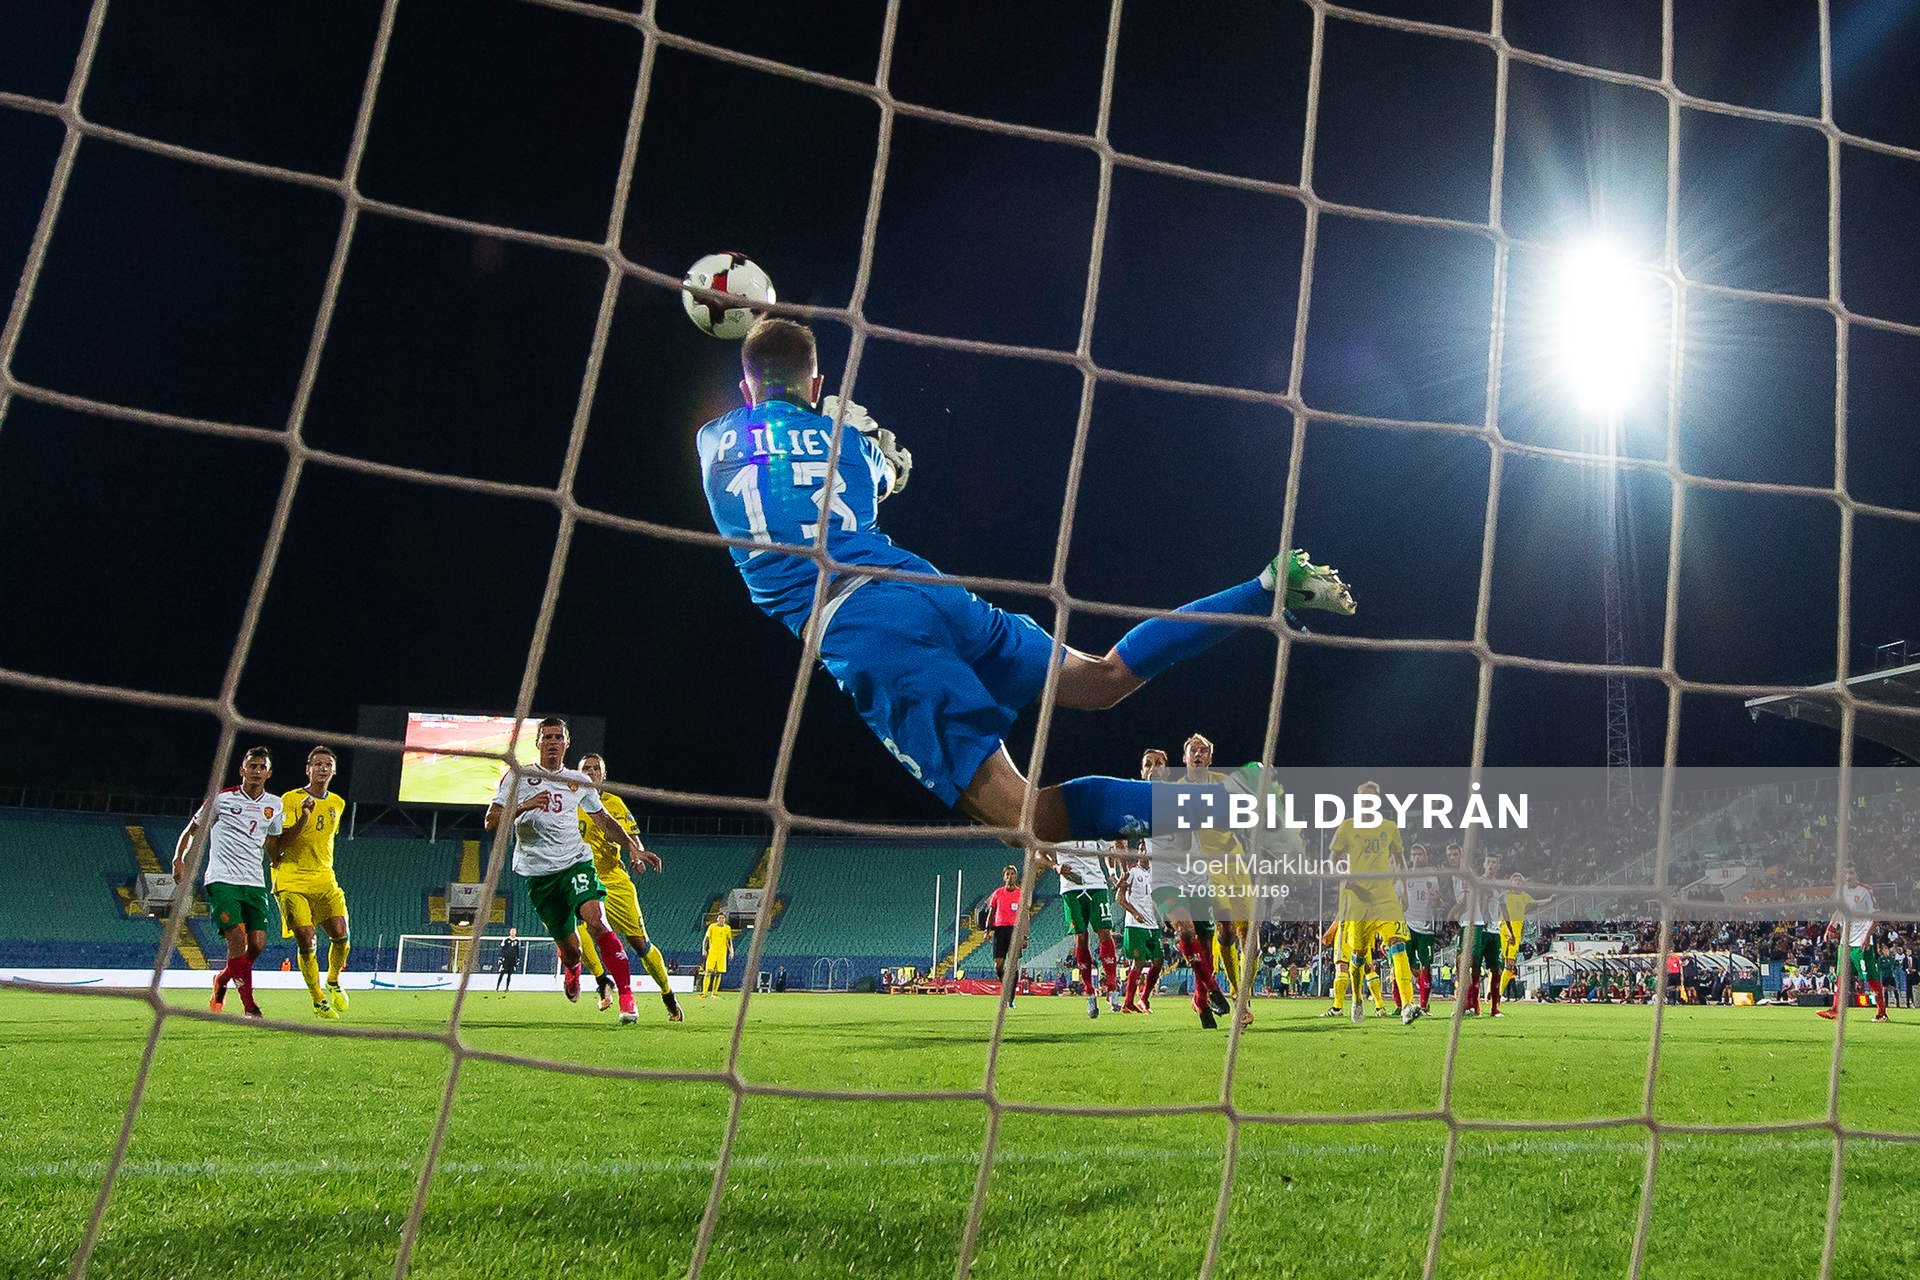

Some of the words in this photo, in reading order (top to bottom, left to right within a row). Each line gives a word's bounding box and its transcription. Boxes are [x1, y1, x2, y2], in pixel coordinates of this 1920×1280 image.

[717, 430, 744, 462] P.
[725, 461, 857, 558] 13
[316, 815, 325, 831] 8
